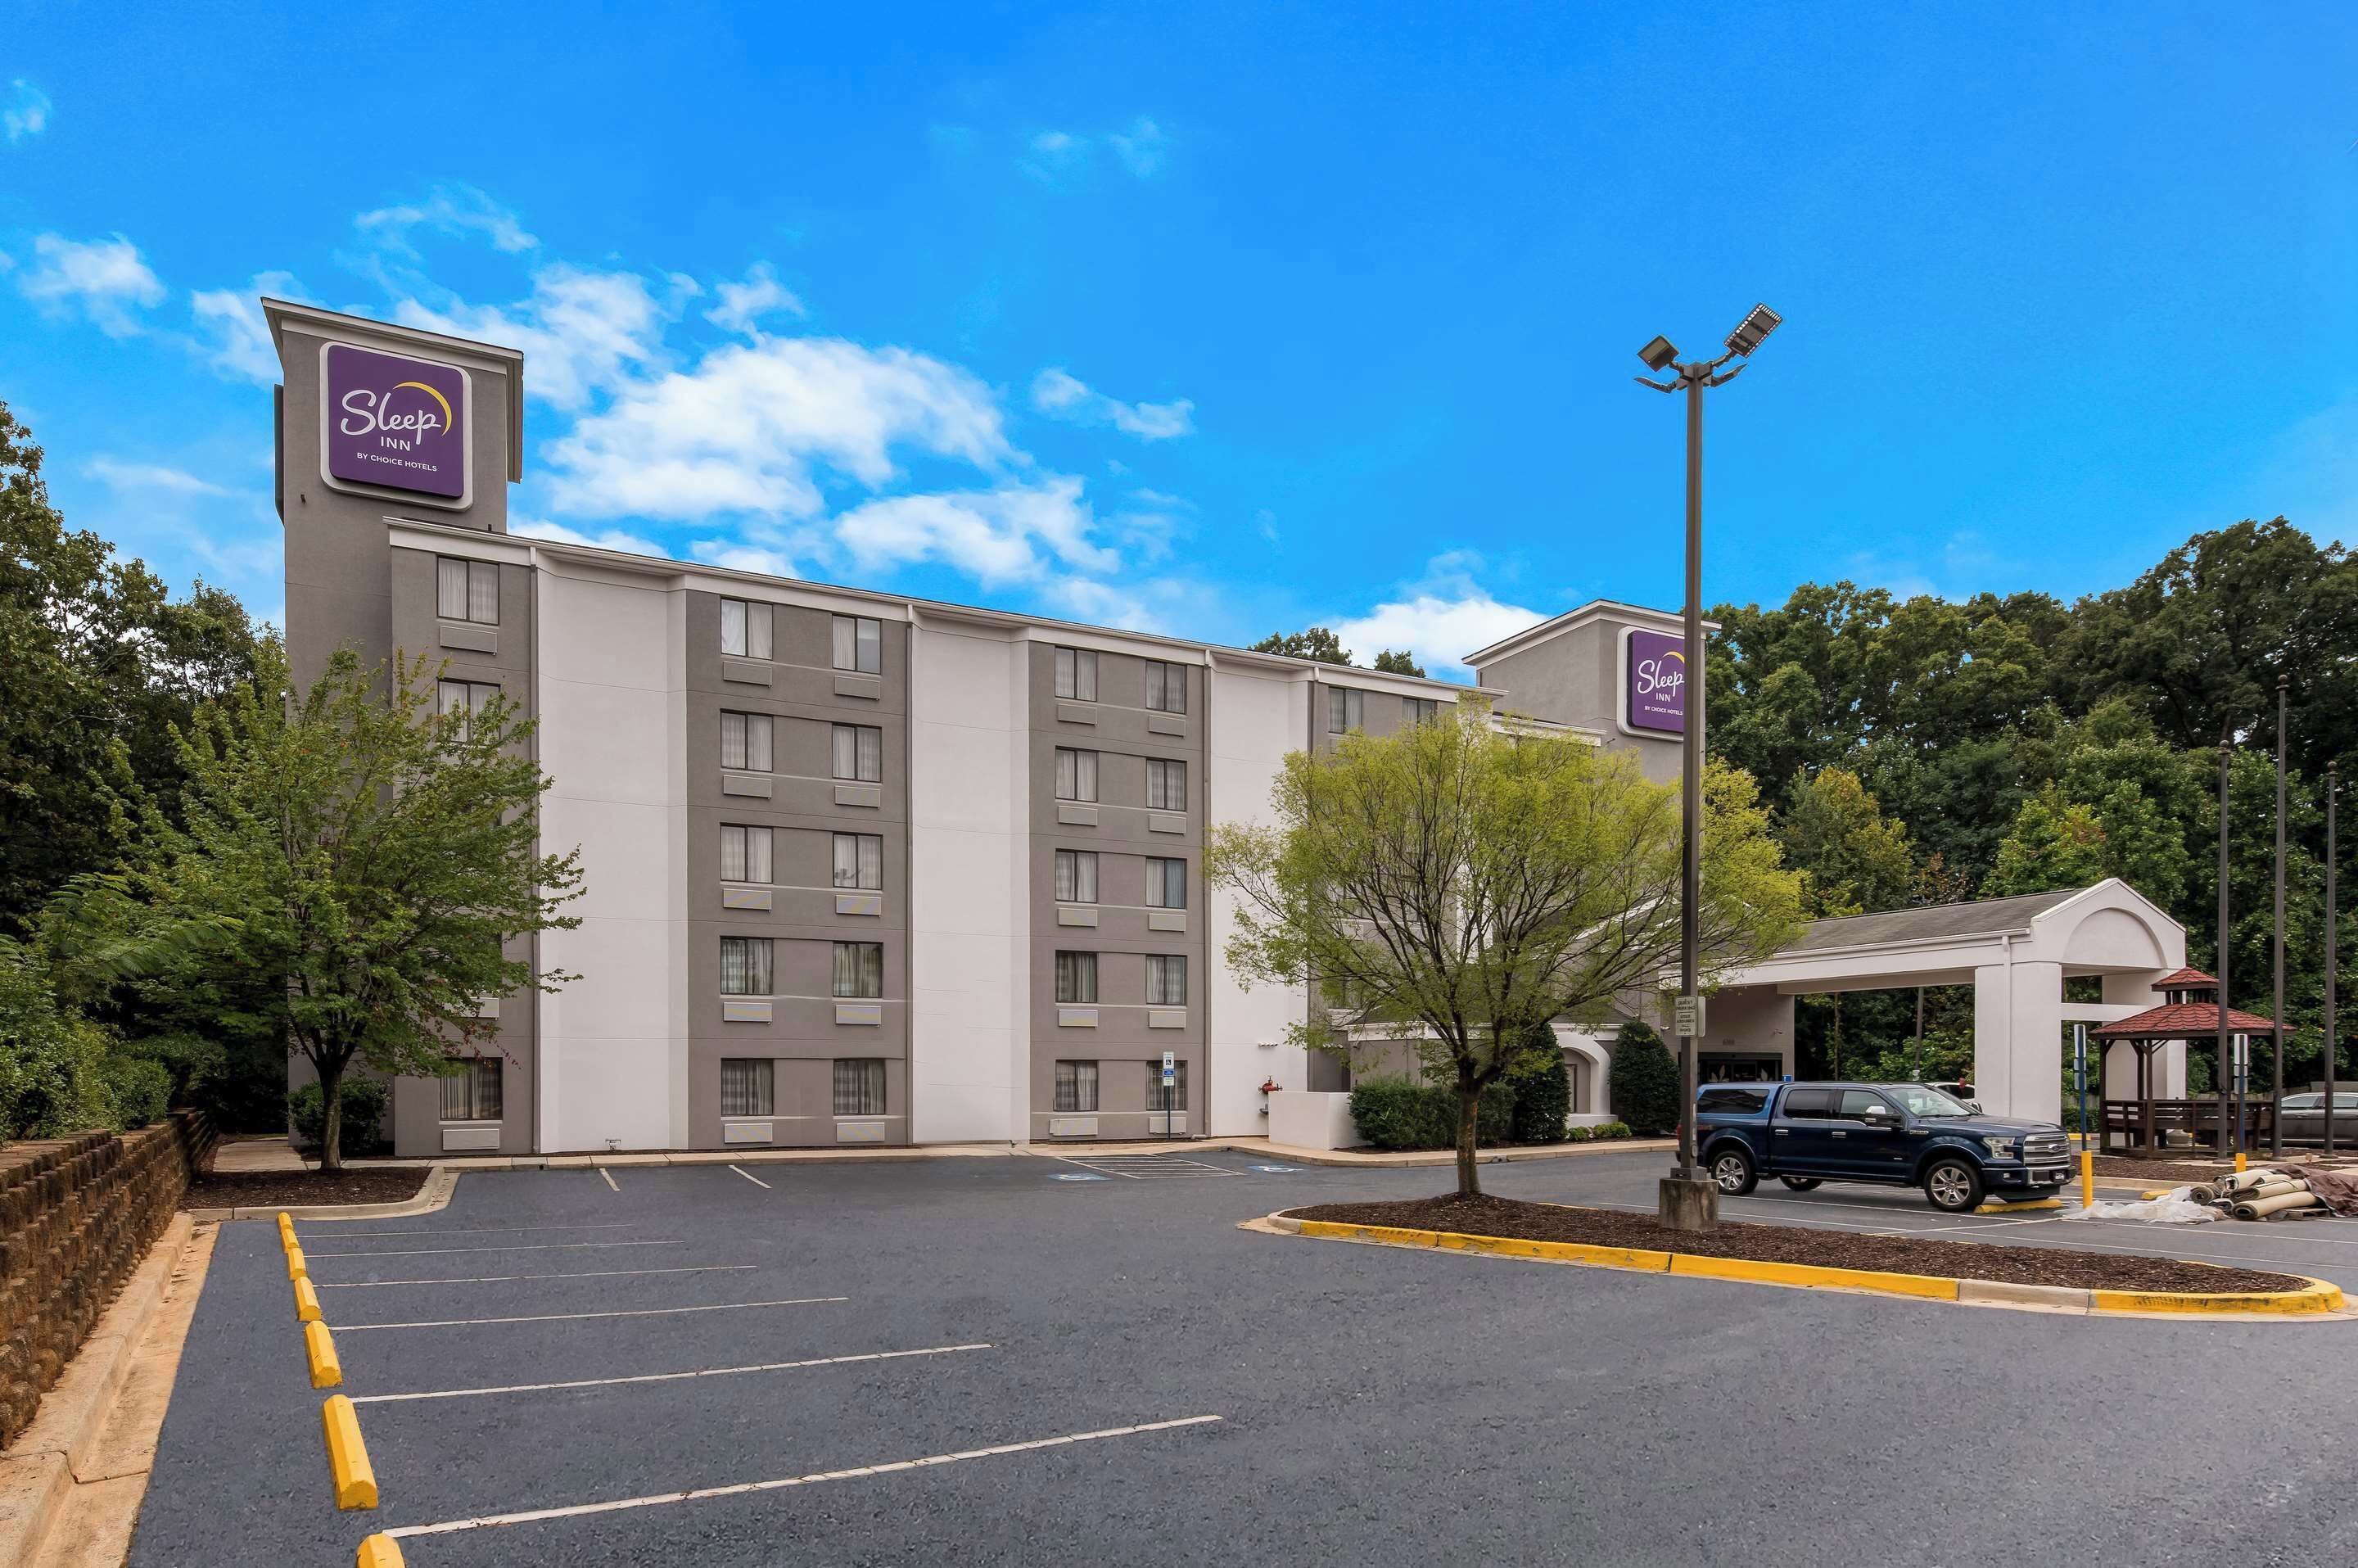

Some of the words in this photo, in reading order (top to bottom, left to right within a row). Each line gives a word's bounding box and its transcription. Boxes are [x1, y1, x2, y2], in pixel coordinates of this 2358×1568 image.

[340, 389, 441, 445] Sleep
[381, 436, 410, 451] INN
[370, 454, 403, 466] CHOICE
[404, 461, 437, 472] HOTELS
[1638, 659, 1685, 697] Sleep
[1656, 693, 1671, 702] INN
